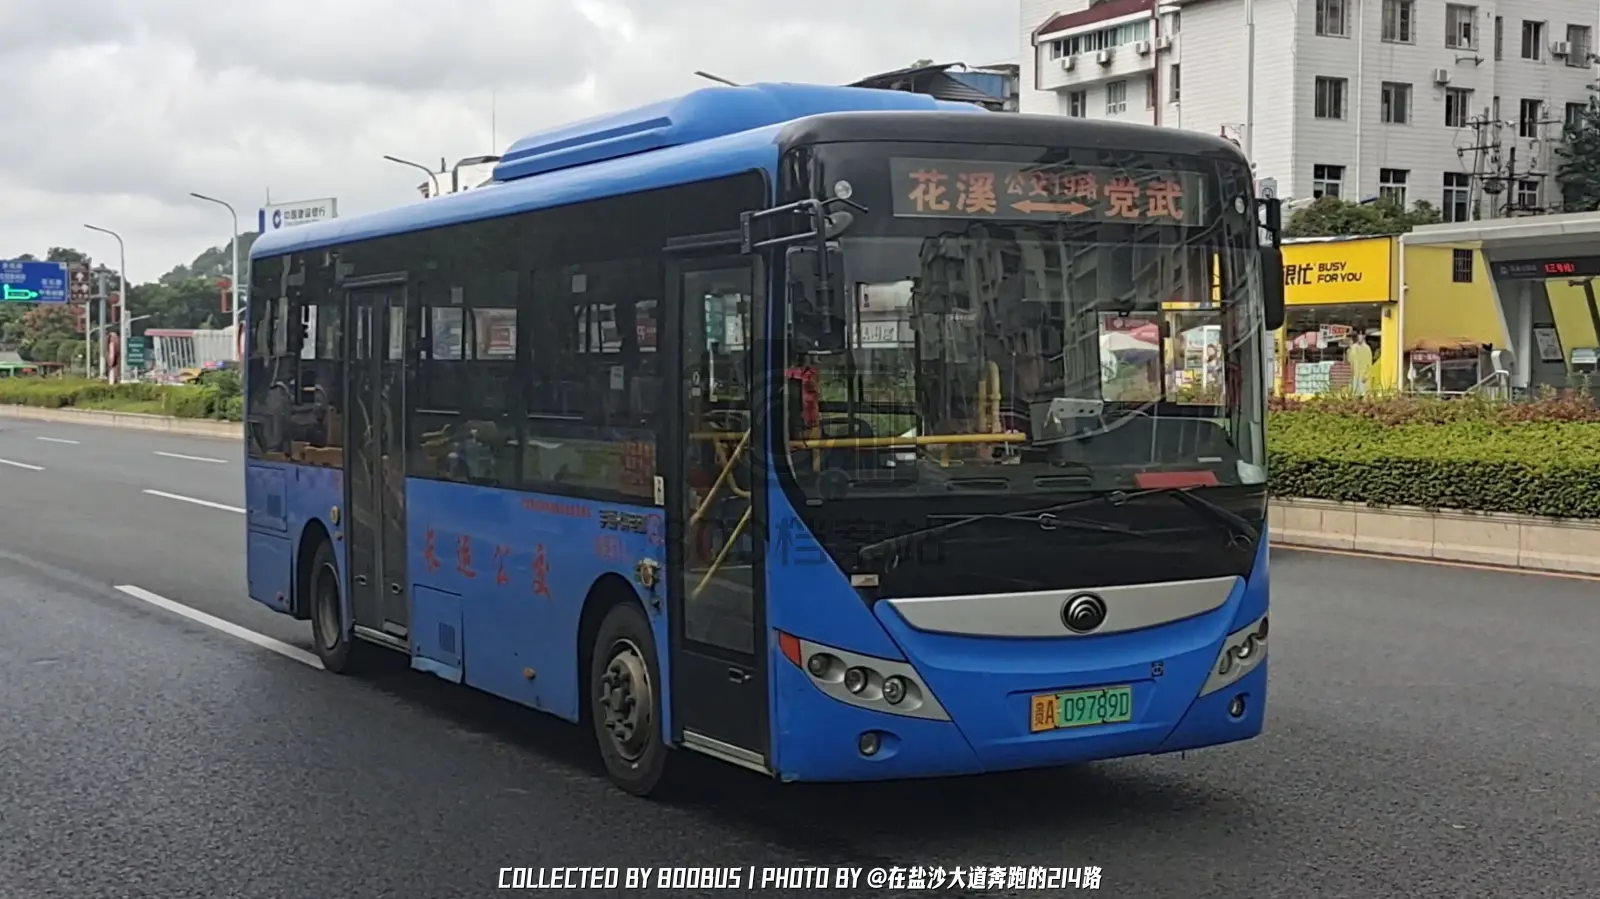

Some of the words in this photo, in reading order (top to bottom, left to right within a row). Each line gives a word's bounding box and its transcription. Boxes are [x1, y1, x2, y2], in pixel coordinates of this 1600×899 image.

[908, 168, 997, 213] 花溪
[1104, 175, 1185, 220] 党武
[1317, 273, 1339, 283] FOR
[1340, 272, 1363, 282] YOU
[1318, 261, 1347, 272] BUSY
